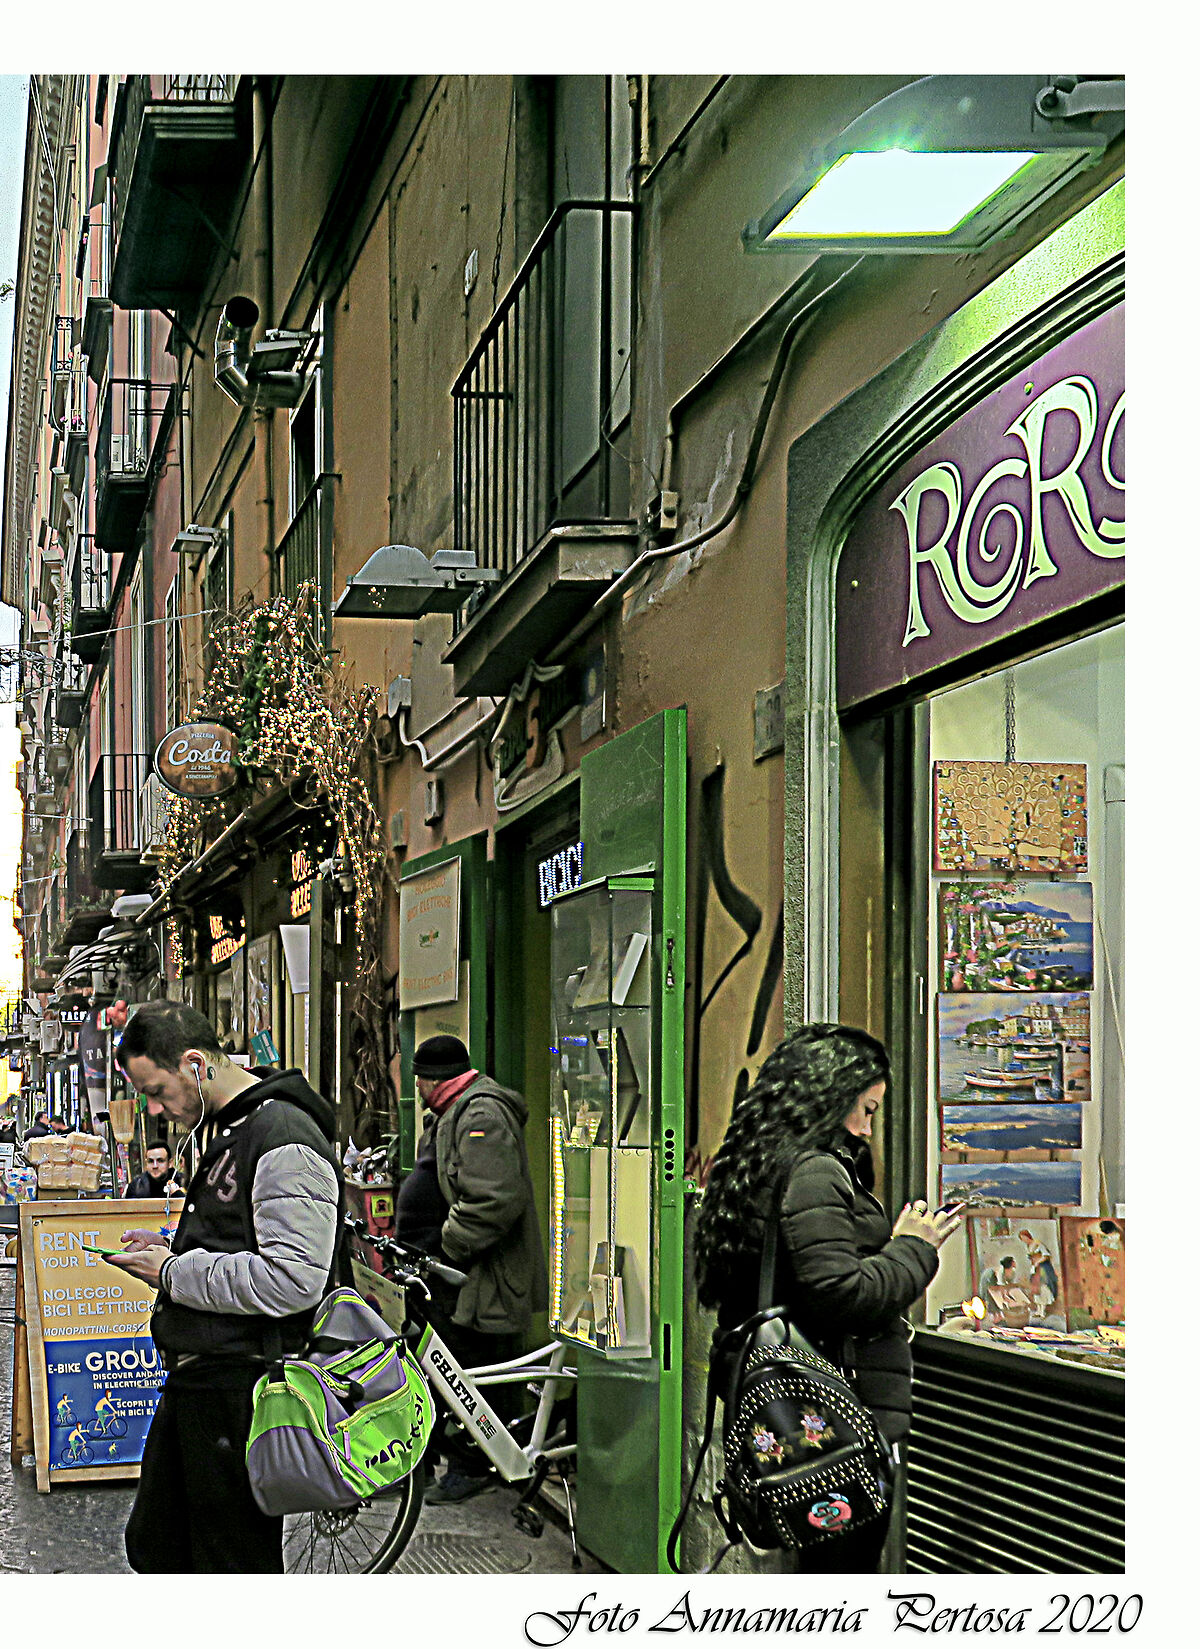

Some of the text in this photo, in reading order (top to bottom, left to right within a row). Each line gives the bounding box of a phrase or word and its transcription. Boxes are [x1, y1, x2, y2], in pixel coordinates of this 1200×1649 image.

[168, 739, 232, 766] Costa
[40, 1231, 100, 1252] RENT
[41, 1256, 79, 1269] YOUR
[43, 1286, 123, 1301] NOLEGGIO
[43, 1304, 72, 1317] BICI
[48, 1349, 158, 1374] E-BIKE GROU
[430, 1349, 478, 1416] GHAETA
[117, 1400, 147, 1409] SCOPRI
[129, 1408, 145, 1416] BICI
